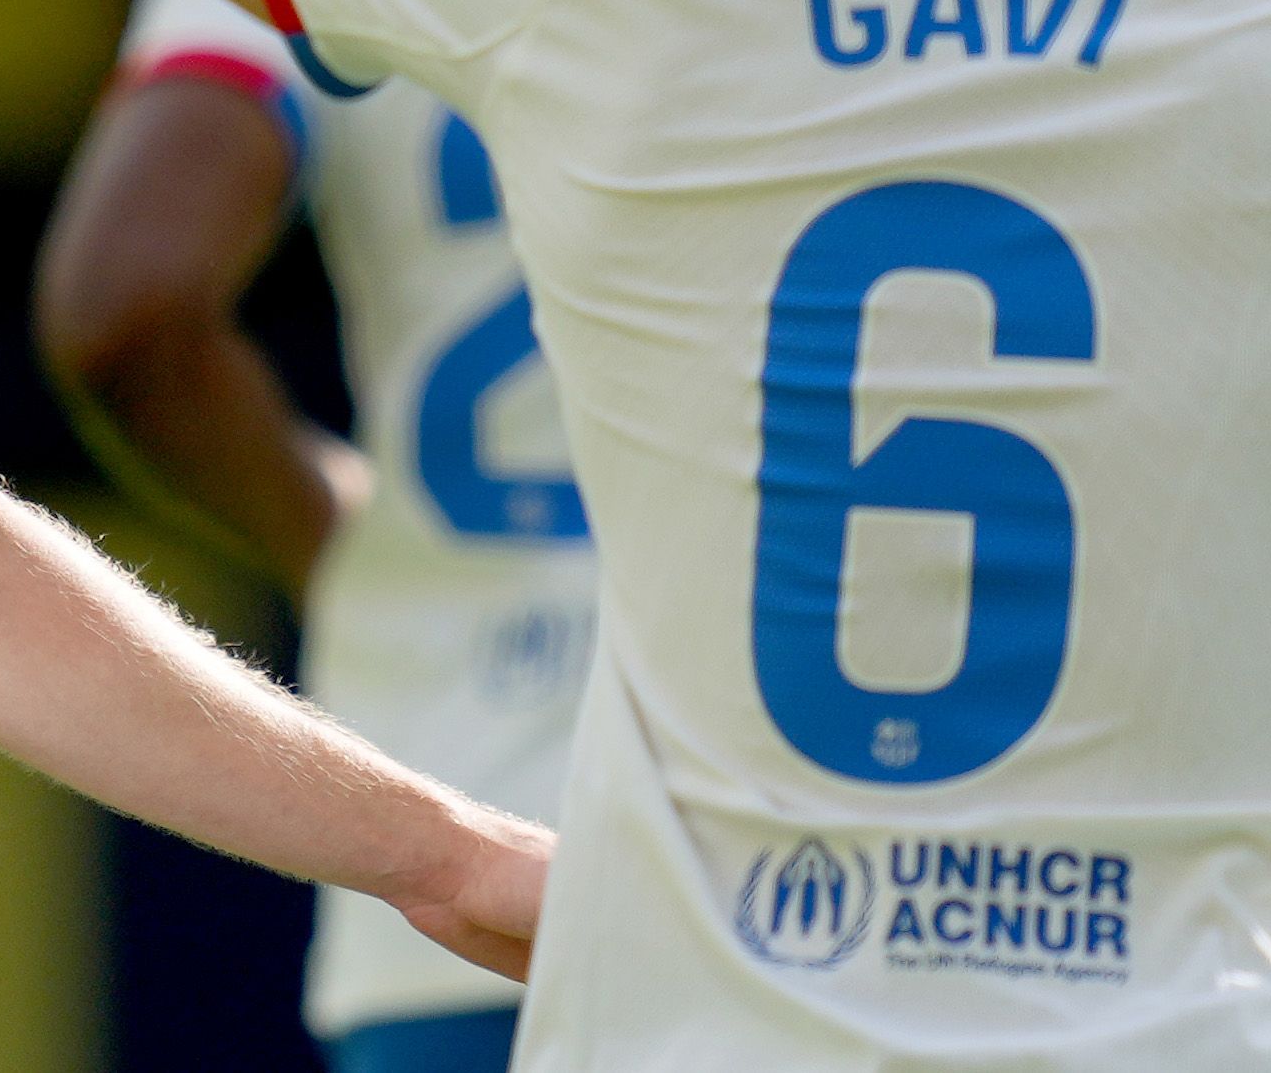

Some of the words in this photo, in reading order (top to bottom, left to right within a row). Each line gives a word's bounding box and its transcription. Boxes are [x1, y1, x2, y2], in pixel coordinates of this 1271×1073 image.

[751, 180, 1098, 788] 6
[889, 843, 1132, 903] UNHCR
[887, 899, 1130, 958] ACNUR
